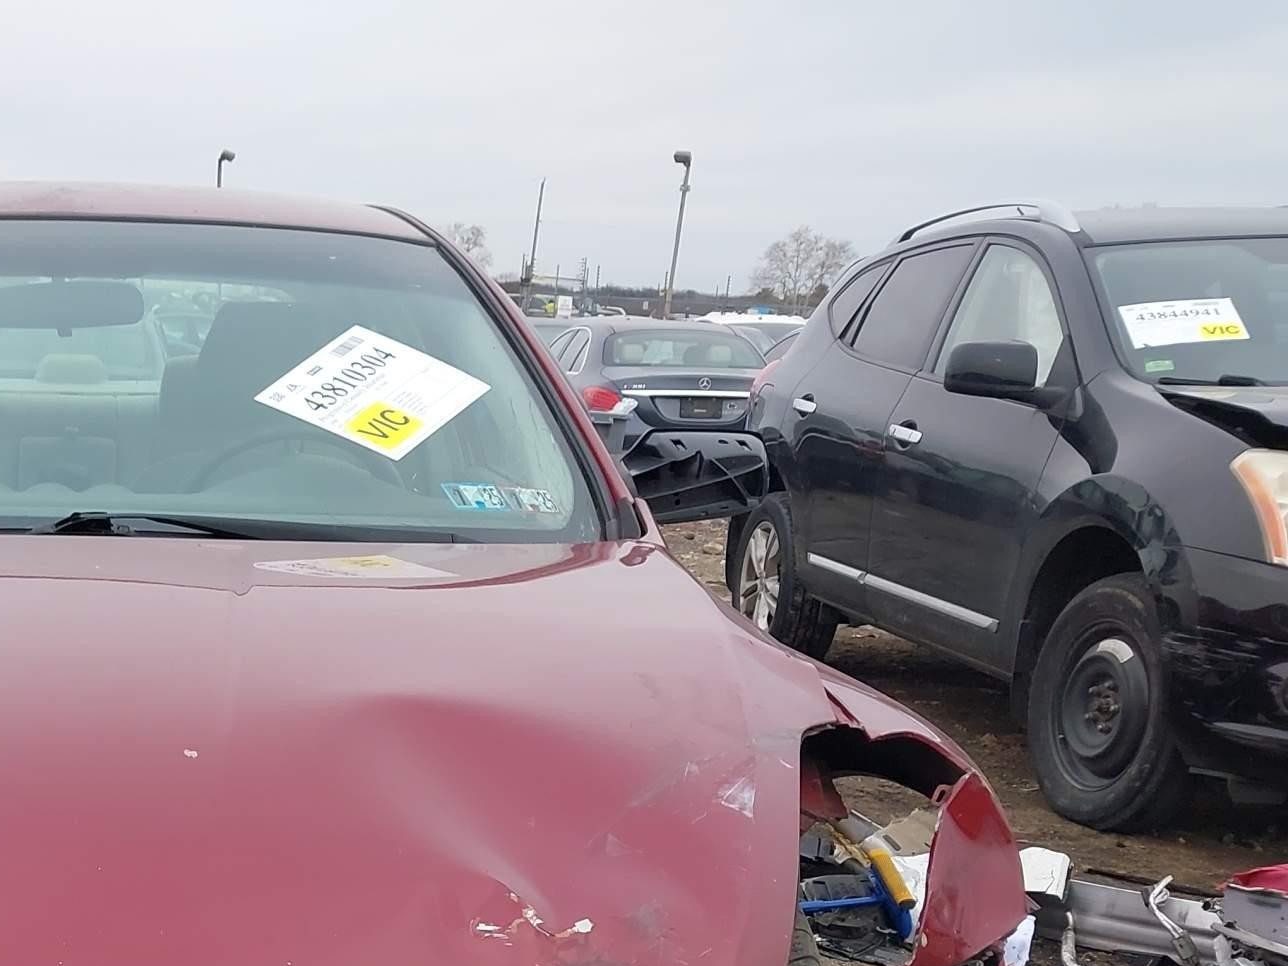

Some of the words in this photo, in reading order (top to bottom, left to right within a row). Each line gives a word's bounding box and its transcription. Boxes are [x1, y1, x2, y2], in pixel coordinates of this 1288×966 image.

[1201, 325, 1241, 335] VIC
[304, 346, 397, 412] 43810304
[357, 409, 411, 439] VIC
